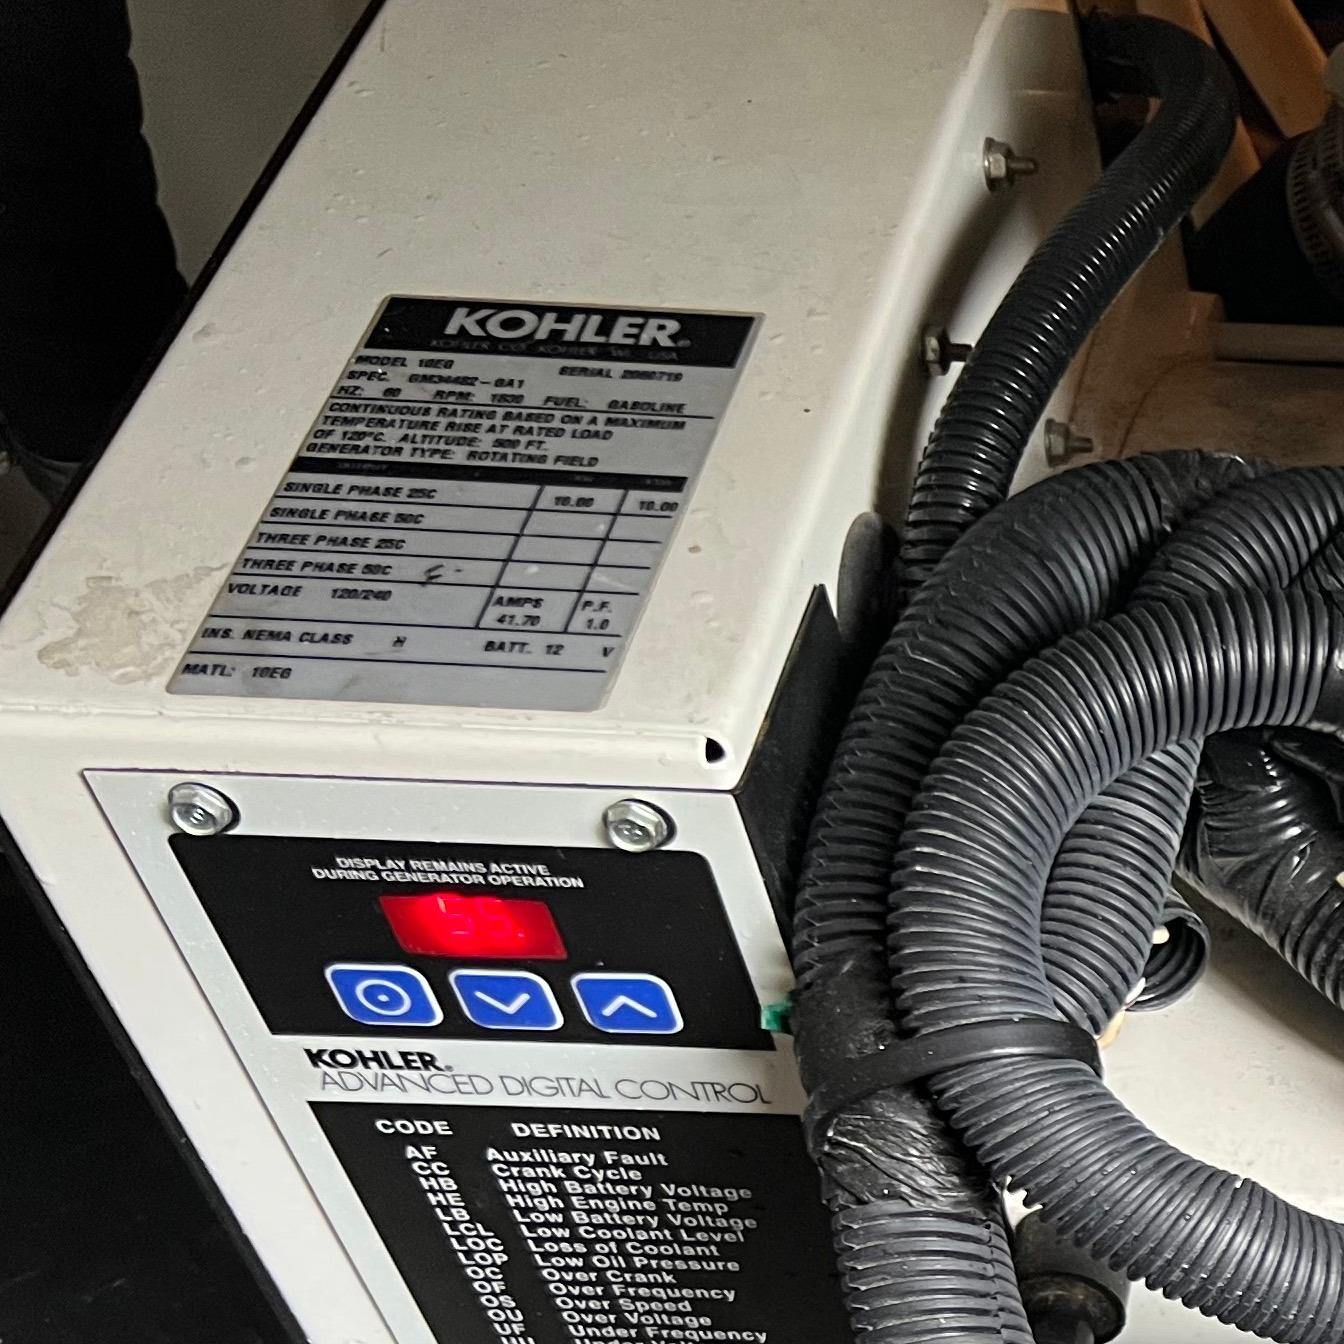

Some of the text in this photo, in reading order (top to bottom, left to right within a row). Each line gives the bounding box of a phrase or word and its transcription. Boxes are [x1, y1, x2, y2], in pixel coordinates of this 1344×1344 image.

[443, 307, 684, 347] KOHLER
[571, 429, 613, 440] LOAD
[284, 482, 403, 498] SINGLE PHASE
[269, 507, 390, 524] SINGLE PHASE
[256, 532, 372, 549] THREE PHASE
[241, 558, 358, 575] THREE PHASE
[299, 632, 354, 645] CLASS
[335, 857, 549, 877] DISPLAY REMAINS ACTIVE
[312, 868, 585, 888] DURING GENERATOR OPERATION
[304, 1048, 444, 1072] KOHLER
[320, 1071, 772, 1105] ADVANCED DIGITAL CONTROL
[375, 1119, 661, 1142] CODE DEFINITION
[405, 1145, 437, 1159] AF
[486, 1148, 669, 1167] Auxiliary Fault
[411, 1161, 450, 1175] CC
[491, 1163, 643, 1183] Crank Cycle
[418, 1176, 458, 1191] HB
[499, 1178, 752, 1201] High Battery Voltage
[426, 1192, 465, 1207] HE
[505, 1194, 729, 1216] High Engine Temp
[434, 1207, 470, 1221] LB
[513, 1209, 758, 1231] Low Battery Voltage
[442, 1222, 494, 1237] LCL
[519, 1224, 745, 1243] Low Coolant Level
[449, 1237, 504, 1251] LOC
[527, 1239, 721, 1257] Loss of Coolant
[457, 1251, 508, 1266] LOP
[533, 1254, 740, 1272] Low Oil Pressure
[465, 1266, 503, 1280] OC
[541, 1268, 678, 1285] Over Crank
[472, 1280, 506, 1294] OF
[549, 1282, 736, 1302] Over Frequency
[480, 1294, 516, 1308] OS
[554, 1296, 693, 1314] Over Speed
[486, 1308, 524, 1323] OU
[561, 1310, 712, 1329] Over Voltage
[493, 1322, 526, 1336] UF
[567, 1323, 768, 1344] Under Frequency
